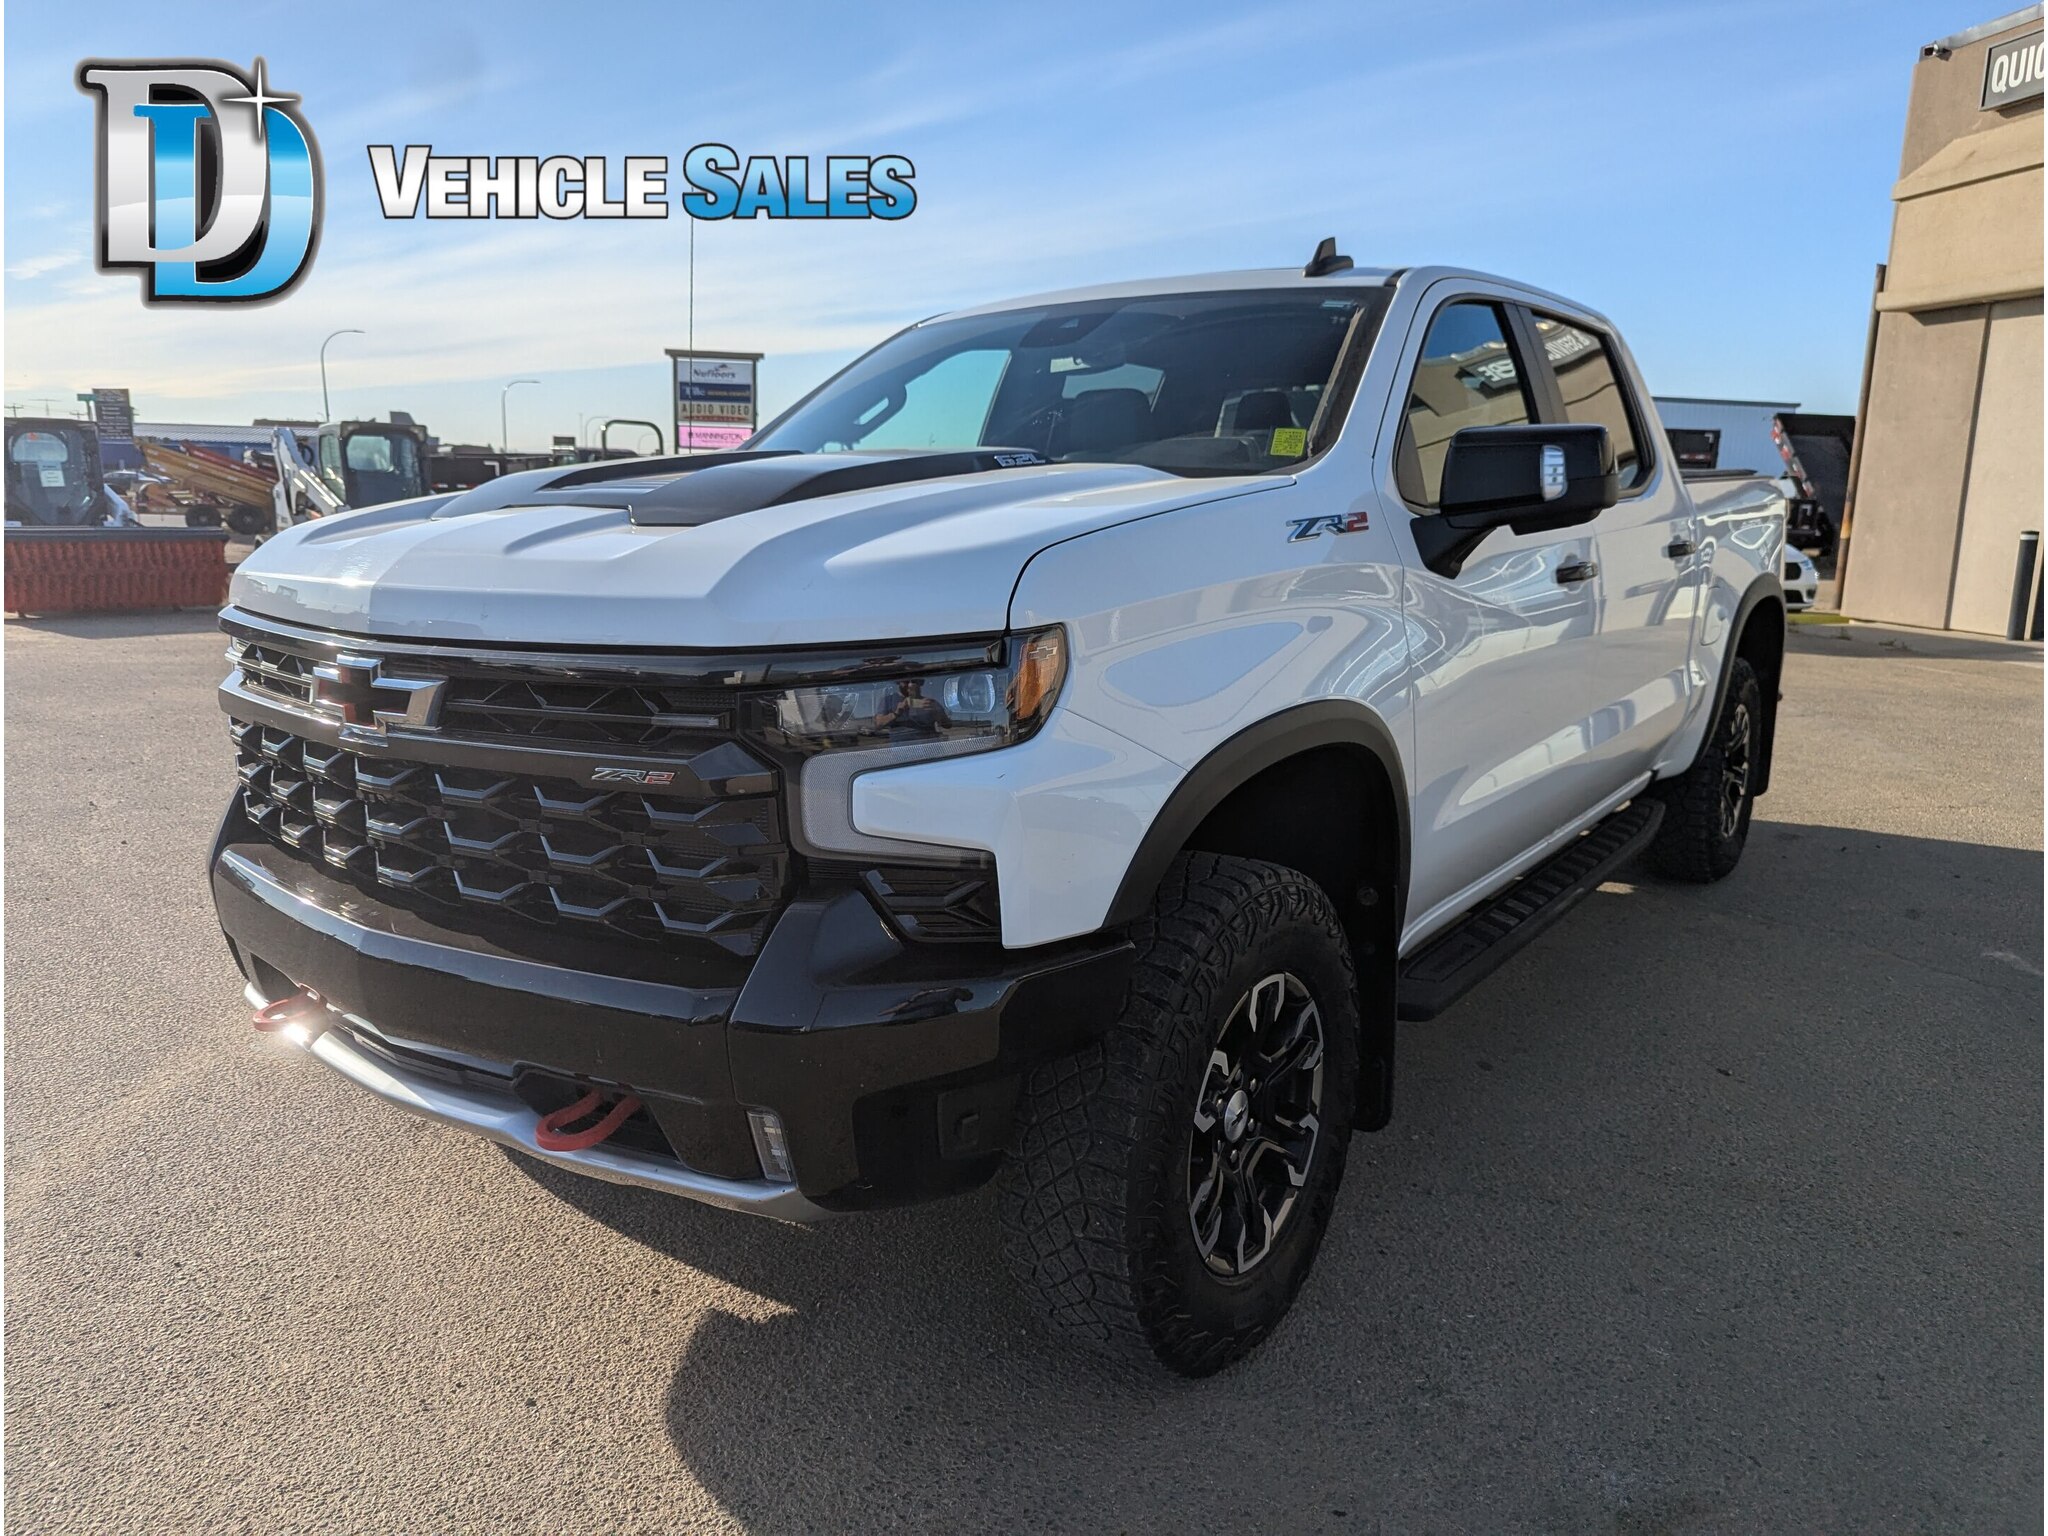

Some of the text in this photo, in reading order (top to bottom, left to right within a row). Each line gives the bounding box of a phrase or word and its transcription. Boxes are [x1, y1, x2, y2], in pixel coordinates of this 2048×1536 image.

[682, 403, 750, 416] AUDIO VIDEO
[1286, 511, 1369, 543] ZR2
[591, 767, 675, 785] ZR2
